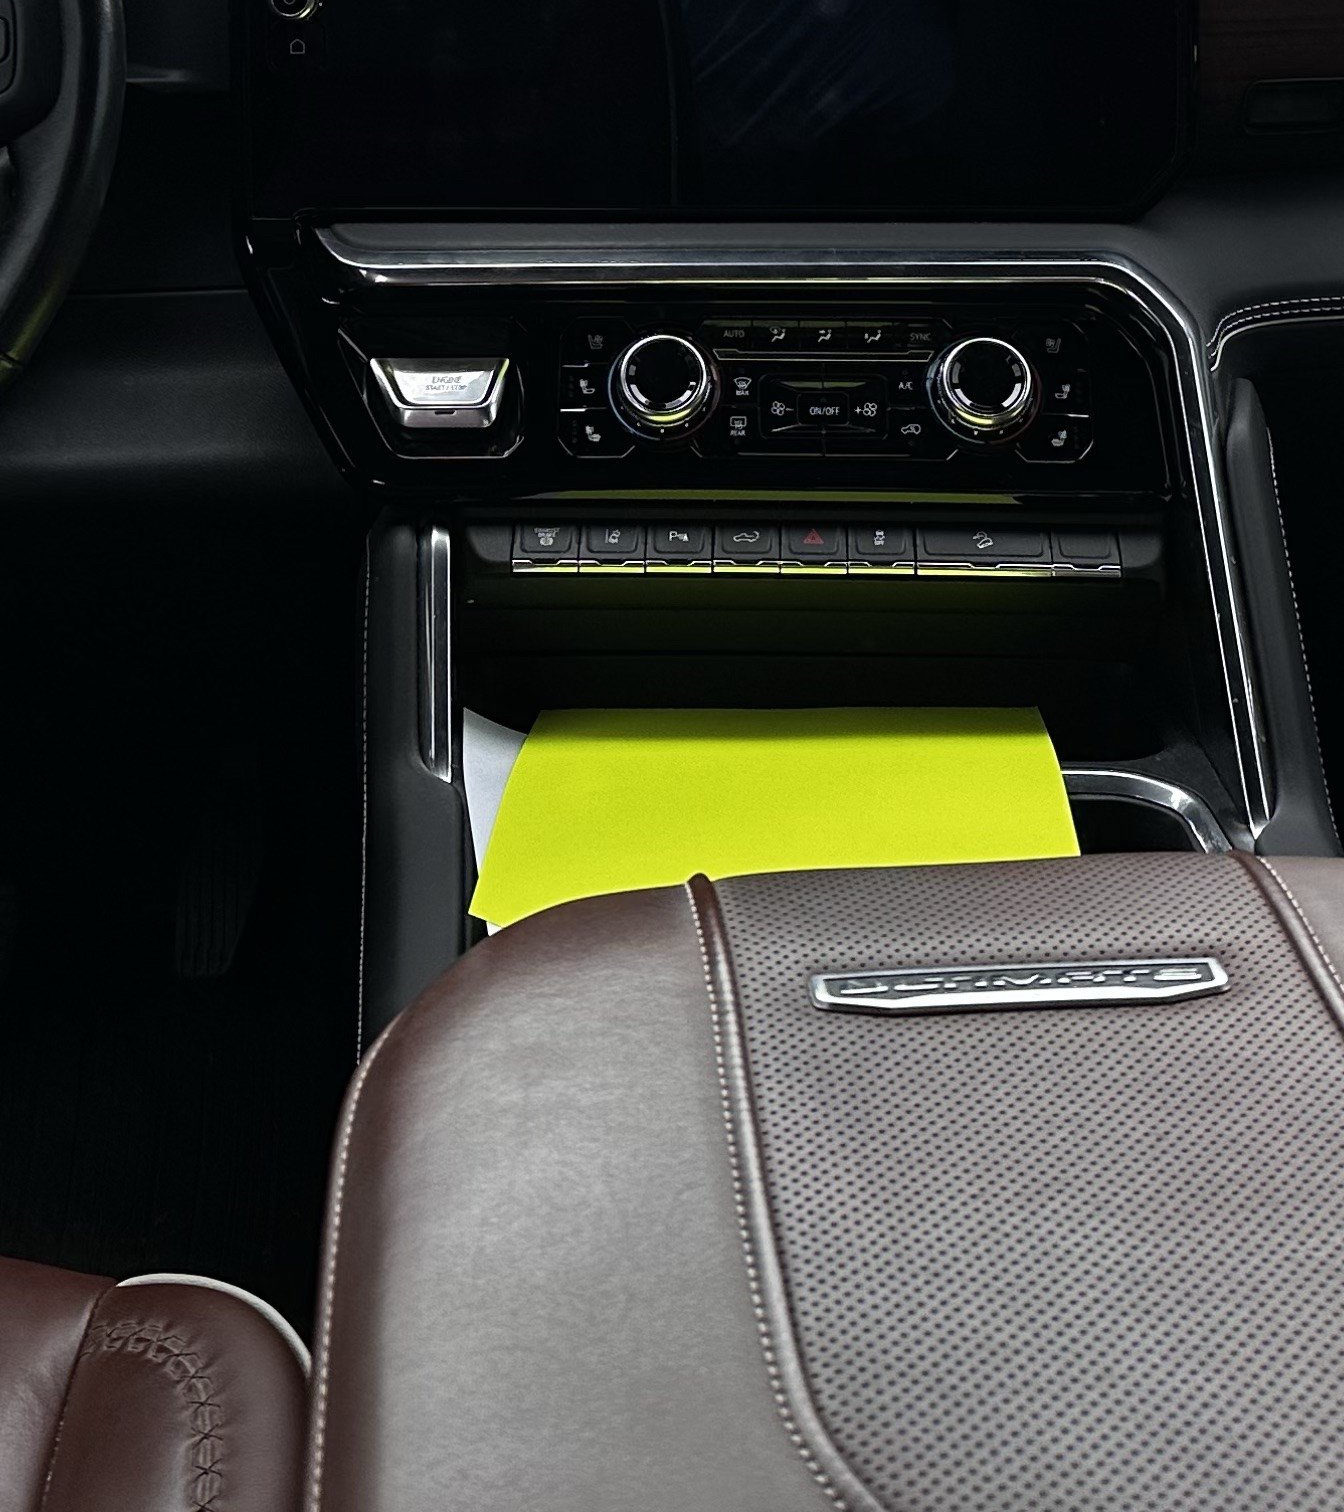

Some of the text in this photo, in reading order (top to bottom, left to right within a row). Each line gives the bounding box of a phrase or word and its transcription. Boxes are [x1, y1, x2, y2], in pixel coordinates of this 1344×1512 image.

[723, 330, 745, 338] AUTO
[909, 332, 931, 342] SYNC
[809, 406, 841, 417] ON/OFF
